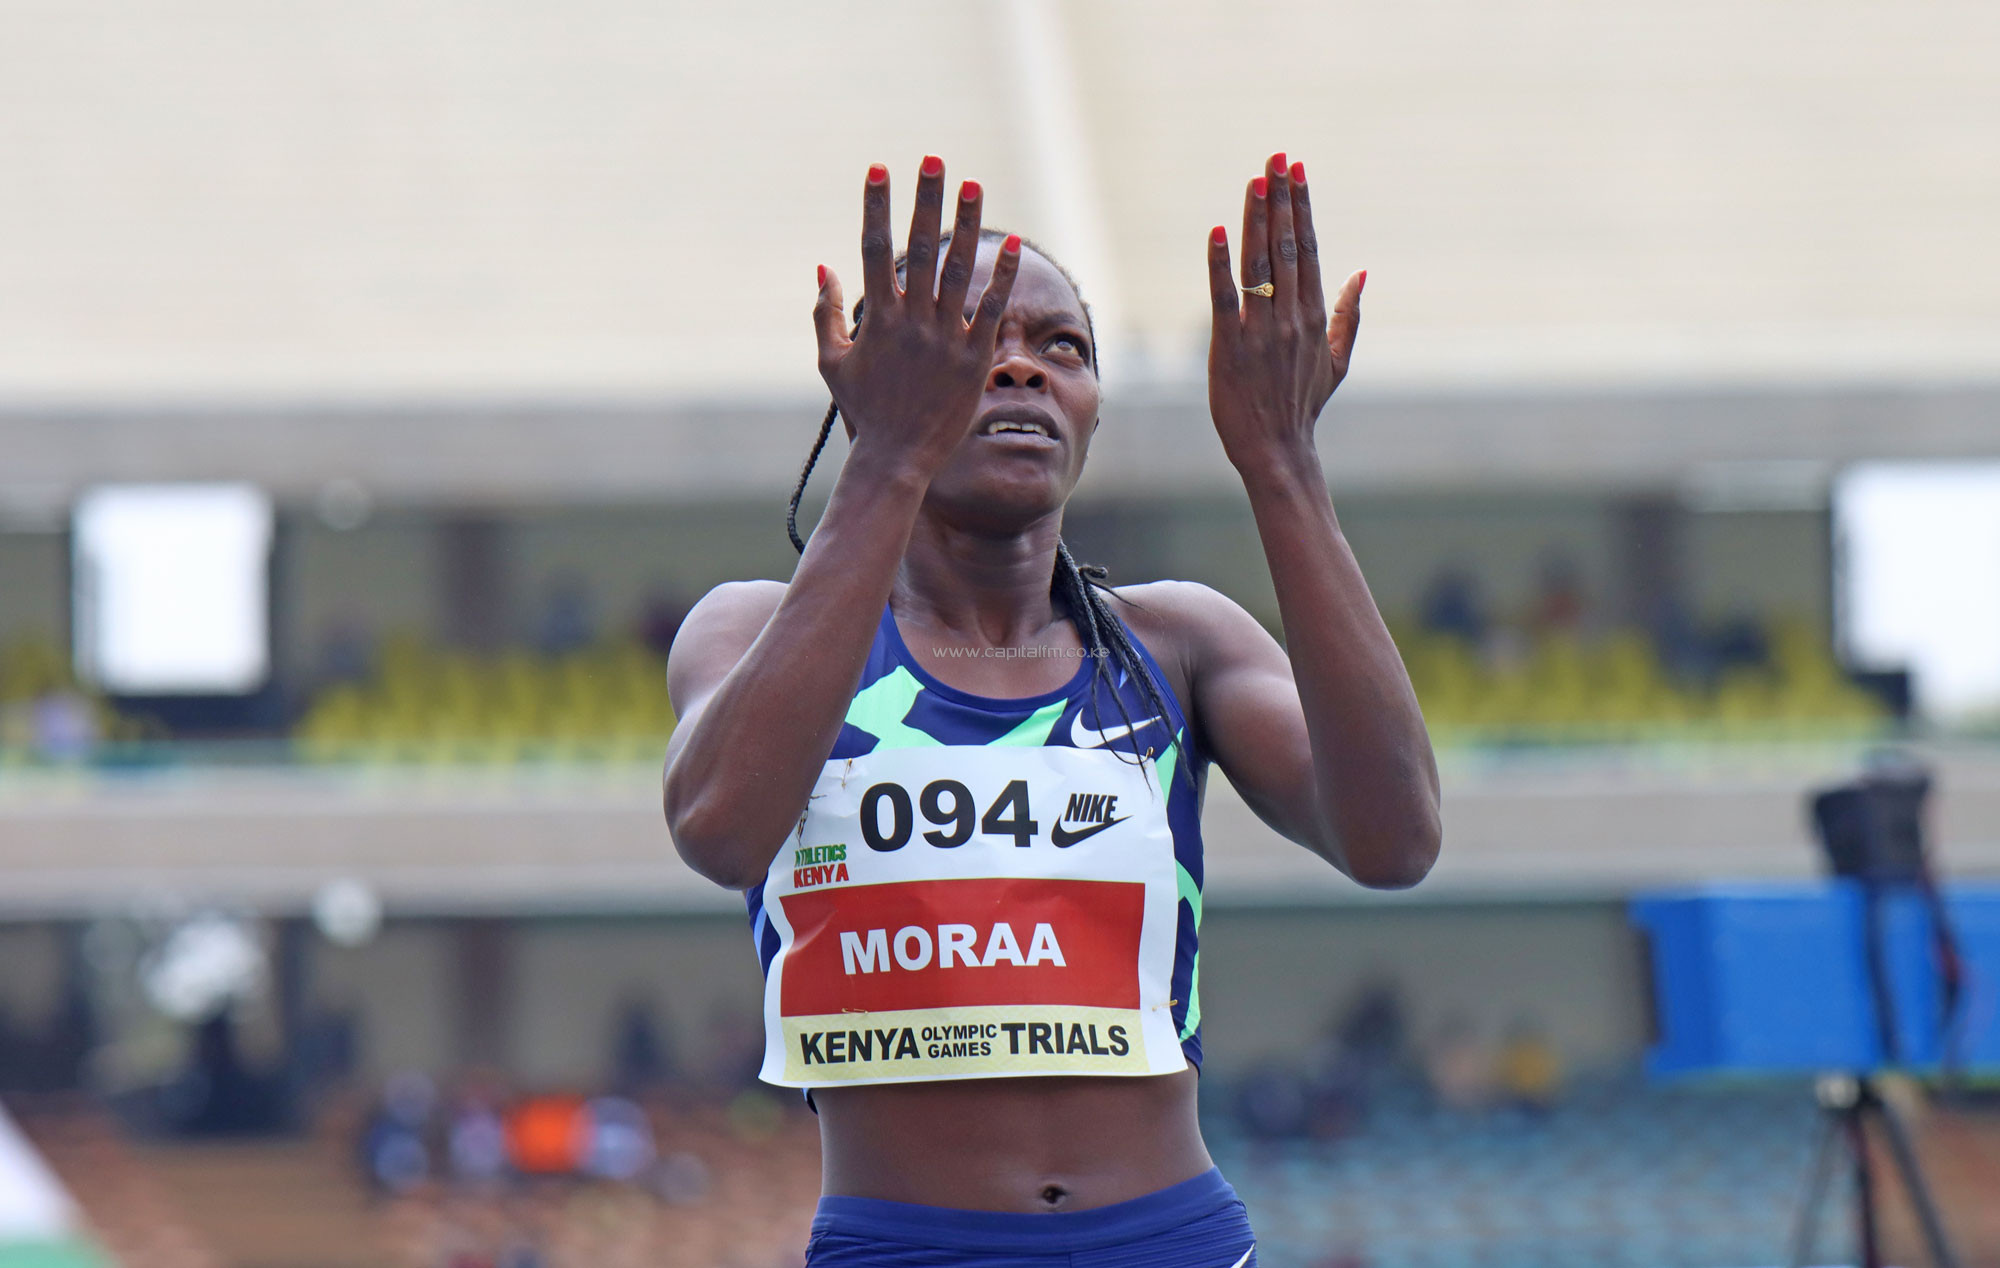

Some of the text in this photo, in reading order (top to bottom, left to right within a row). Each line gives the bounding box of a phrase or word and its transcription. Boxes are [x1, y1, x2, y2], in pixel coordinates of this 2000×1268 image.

[860, 779, 1038, 852] 094
[1064, 793, 1118, 823] NIKE
[793, 863, 849, 888] KENYA
[839, 923, 1066, 975] MORAA
[800, 1022, 1130, 1064] KENYA OLYMPIC GAMES TRIALS
